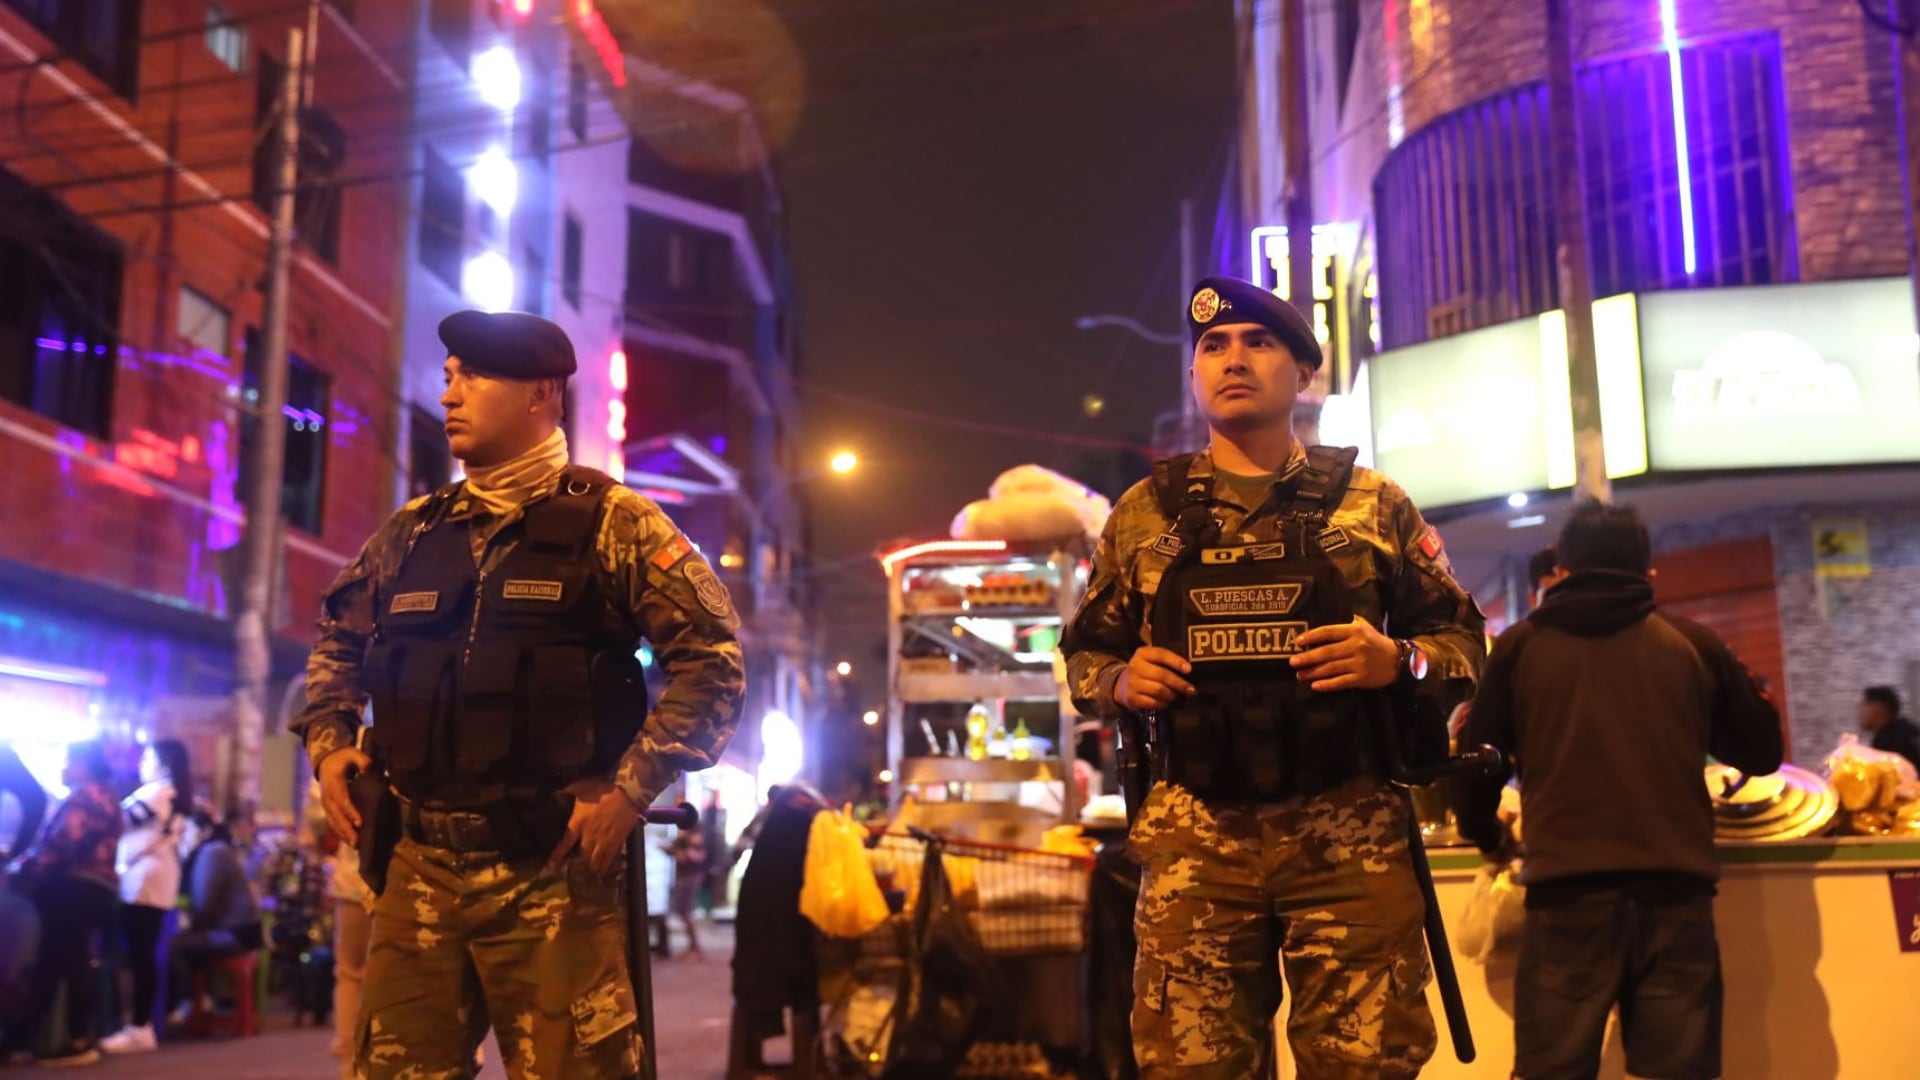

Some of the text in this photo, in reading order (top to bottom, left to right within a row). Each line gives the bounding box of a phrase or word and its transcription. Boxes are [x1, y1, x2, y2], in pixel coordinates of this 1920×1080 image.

[1319, 532, 1345, 547] ACIONAL
[1200, 589, 1289, 604] L. PUESCAS A.
[1193, 627, 1303, 655] POLICIA
